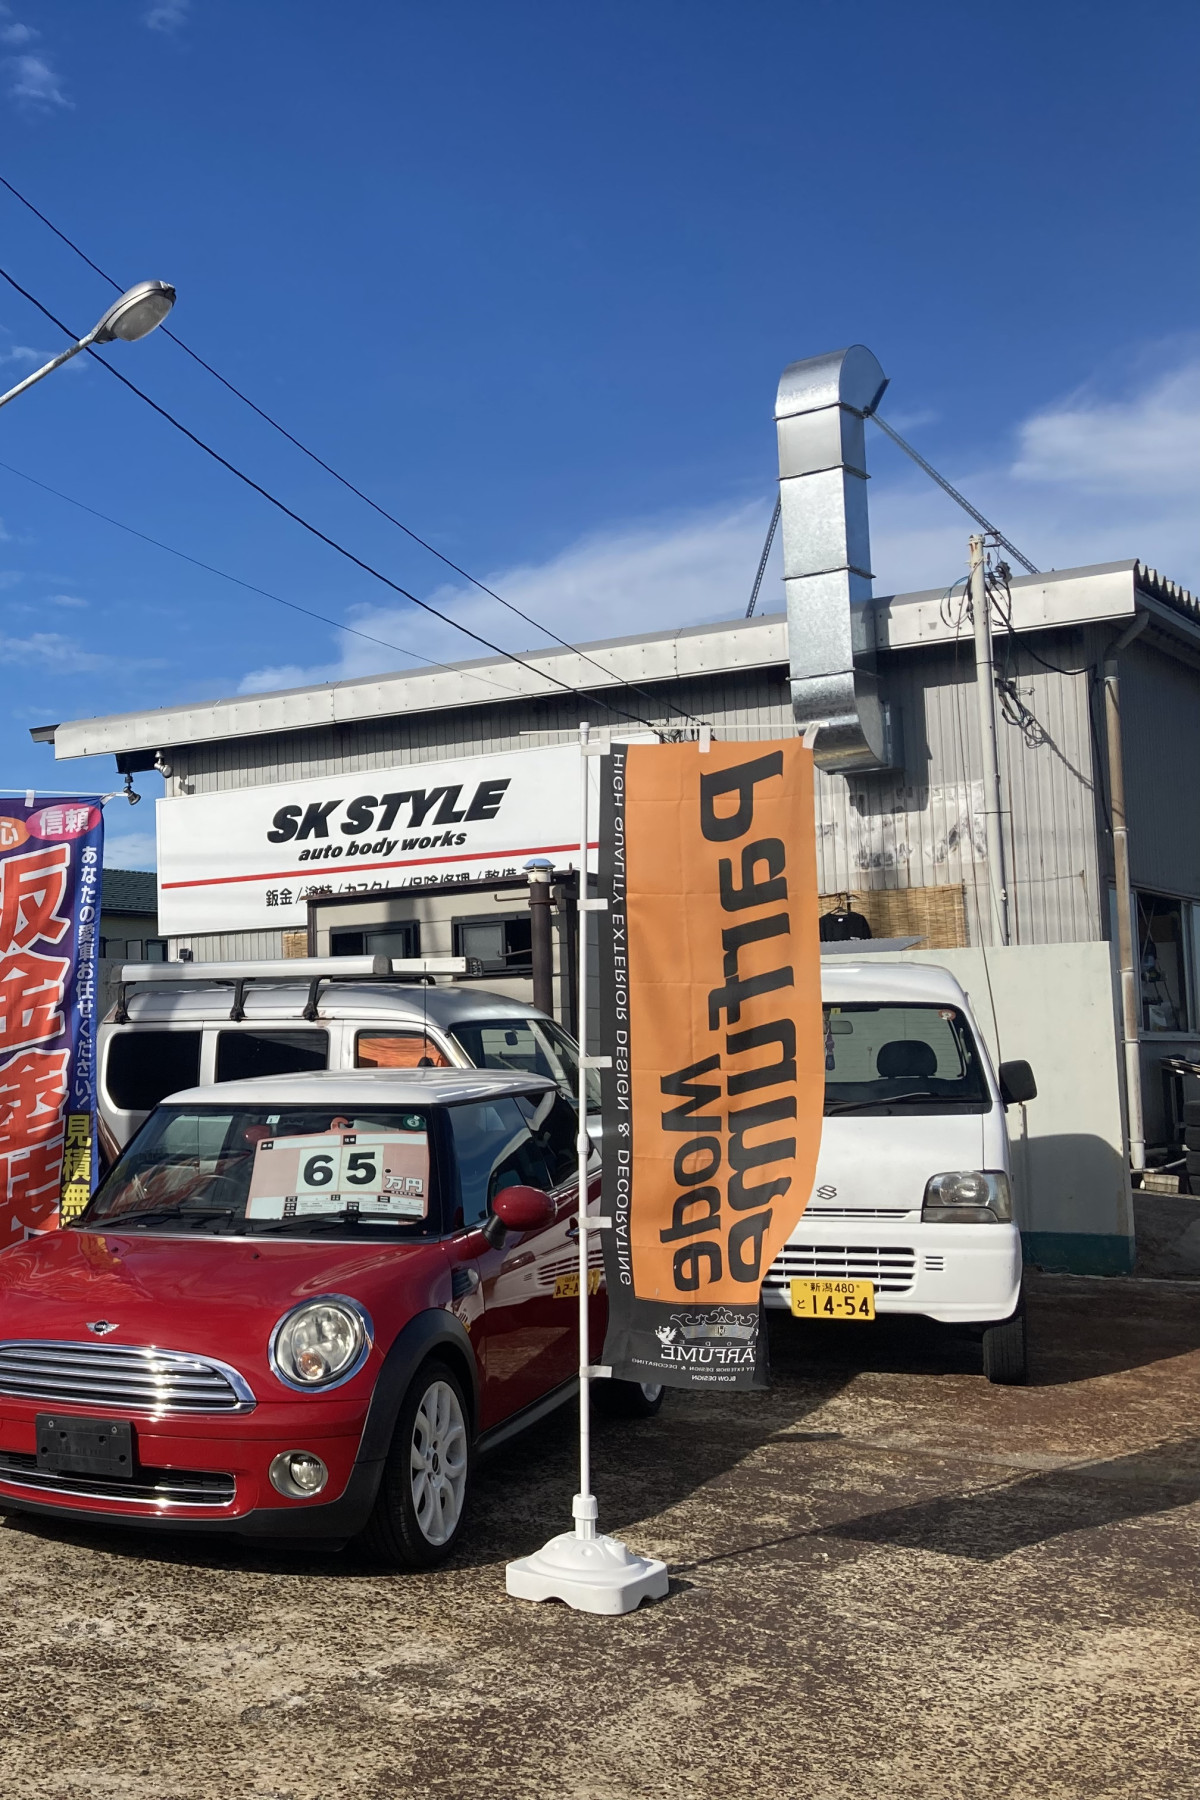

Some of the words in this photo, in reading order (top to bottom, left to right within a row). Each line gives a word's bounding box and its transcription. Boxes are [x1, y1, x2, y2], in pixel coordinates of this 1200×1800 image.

[39, 806, 90, 837] 信頼
[267, 799, 345, 843] SK
[340, 778, 512, 835] STYLE
[298, 844, 344, 862] auto
[345, 837, 400, 857] body
[400, 830, 468, 850] works
[61, 1114, 91, 1227] 見積無
[304, 1152, 377, 1187] 65
[384, 1175, 424, 1193] 万円
[797, 1299, 806, 1309] と
[812, 1294, 870, 1316] 14-54
